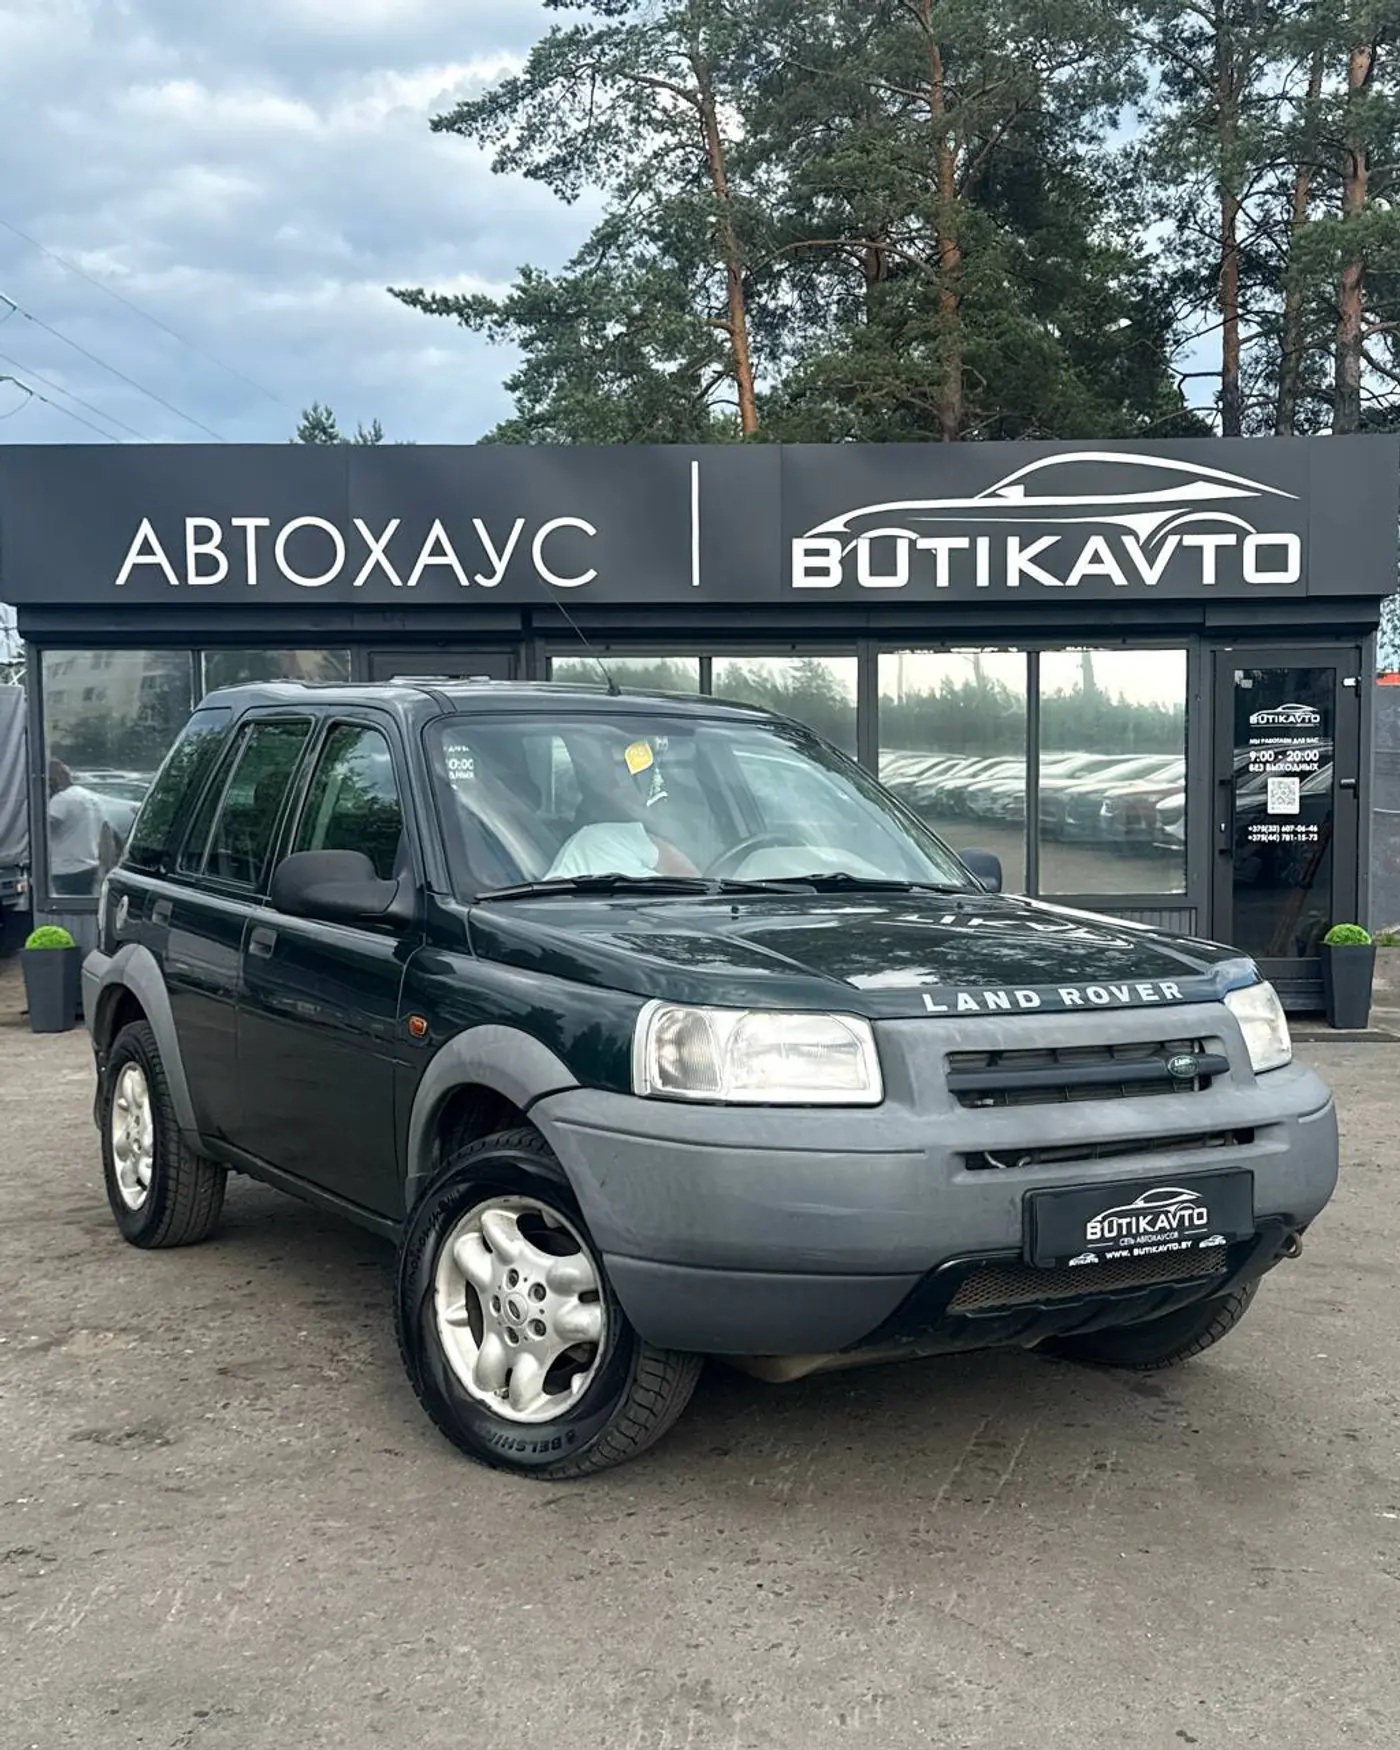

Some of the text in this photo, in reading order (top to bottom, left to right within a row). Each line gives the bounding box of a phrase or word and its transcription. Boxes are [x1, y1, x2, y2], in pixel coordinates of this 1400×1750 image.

[115, 516, 598, 588] АВТОХАУС
[791, 532, 1301, 588] BUTIKAVTO
[1249, 714, 1320, 725] BUTIKAVTO
[1249, 750, 1275, 762] 9:00
[1286, 750, 1319, 762] 20:00
[1265, 762, 1319, 771] ВЫХОДНЫХ
[922, 982, 1184, 1013] LAND ROVER
[1086, 1207, 1208, 1240] BUTIKAVTO
[1105, 1250, 1131, 1260] WWW.
